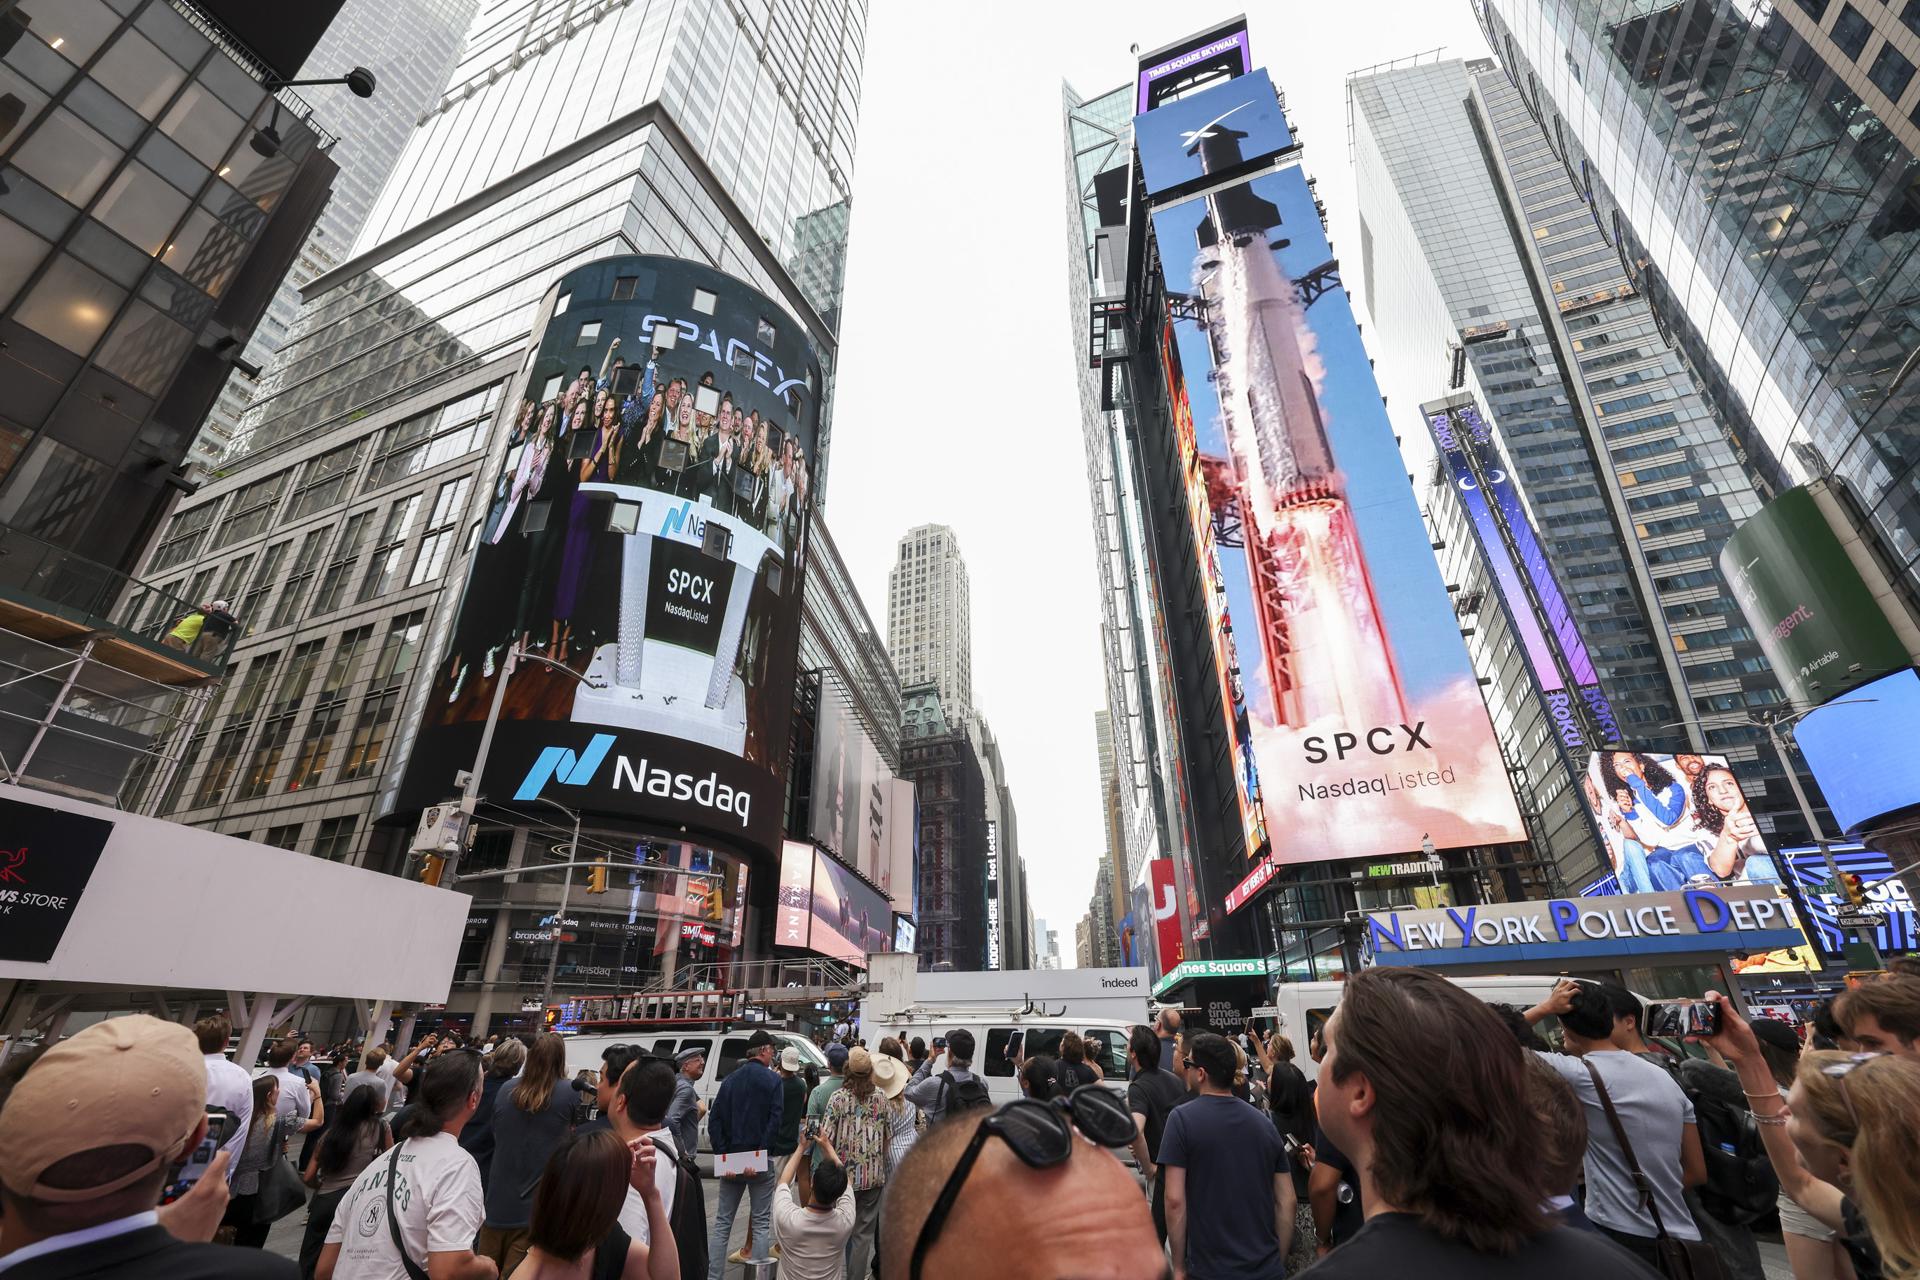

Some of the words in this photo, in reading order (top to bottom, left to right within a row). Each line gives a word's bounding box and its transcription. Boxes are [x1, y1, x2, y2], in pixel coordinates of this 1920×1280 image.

[1148, 64, 1171, 79] TIMES
[1171, 52, 1201, 69] SQUARE
[1200, 36, 1239, 58] SKYWALK
[667, 567, 714, 605] SPCX
[664, 601, 709, 625] NasdaqListed
[1807, 649, 1839, 673] Airtable
[1546, 693, 1584, 748] ROKU
[1303, 721, 1432, 764] SPCX
[612, 755, 751, 828] Nasdaq
[1298, 766, 1456, 801] NasdaqListed
[986, 823, 996, 856] Locker
[987, 858, 997, 880] Foot
[21, 892, 69, 910] STORE
[988, 898, 998, 924] HERE
[590, 921, 619, 930] REWRITE
[621, 923, 656, 933] TOMORROW
[1368, 912, 1445, 955] NEW
[1445, 905, 1549, 949] YORK
[1548, 896, 1681, 943] POLICE
[1682, 888, 1795, 933] DEPT
[1863, 917, 1878, 925] WAY
[514, 931, 552, 941] branded
[575, 964, 611, 977] Nasdaq
[1208, 962, 1255, 976] Square
[1101, 976, 1138, 988] indeed
[1207, 1008, 1241, 1018] times
[1209, 1001, 1232, 1010] one
[1209, 1016, 1249, 1029] square
